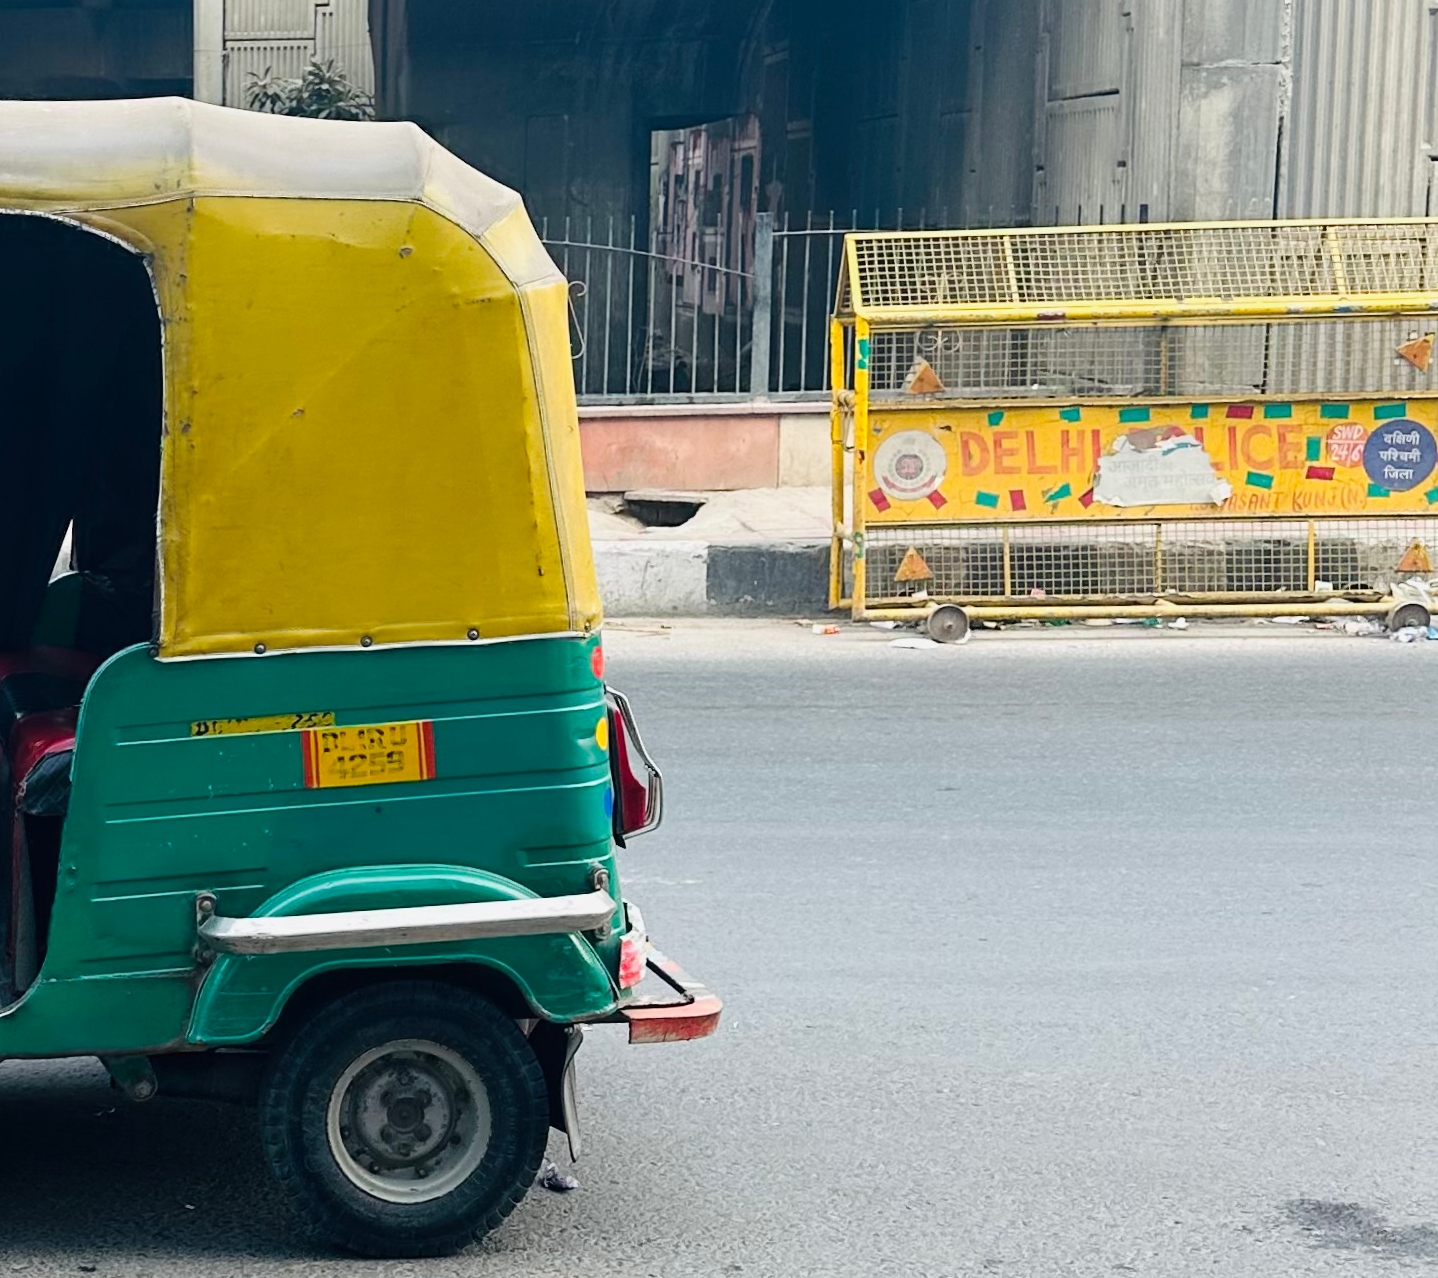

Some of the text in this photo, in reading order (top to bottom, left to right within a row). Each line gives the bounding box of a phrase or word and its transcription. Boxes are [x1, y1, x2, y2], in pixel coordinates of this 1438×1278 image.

[1332, 424, 1364, 440] SWD
[1383, 430, 1420, 446] दक्षिणी
[960, 428, 1101, 476] DELHI
[1378, 447, 1421, 463] पश्चिमी
[1383, 464, 1414, 480] जिला
